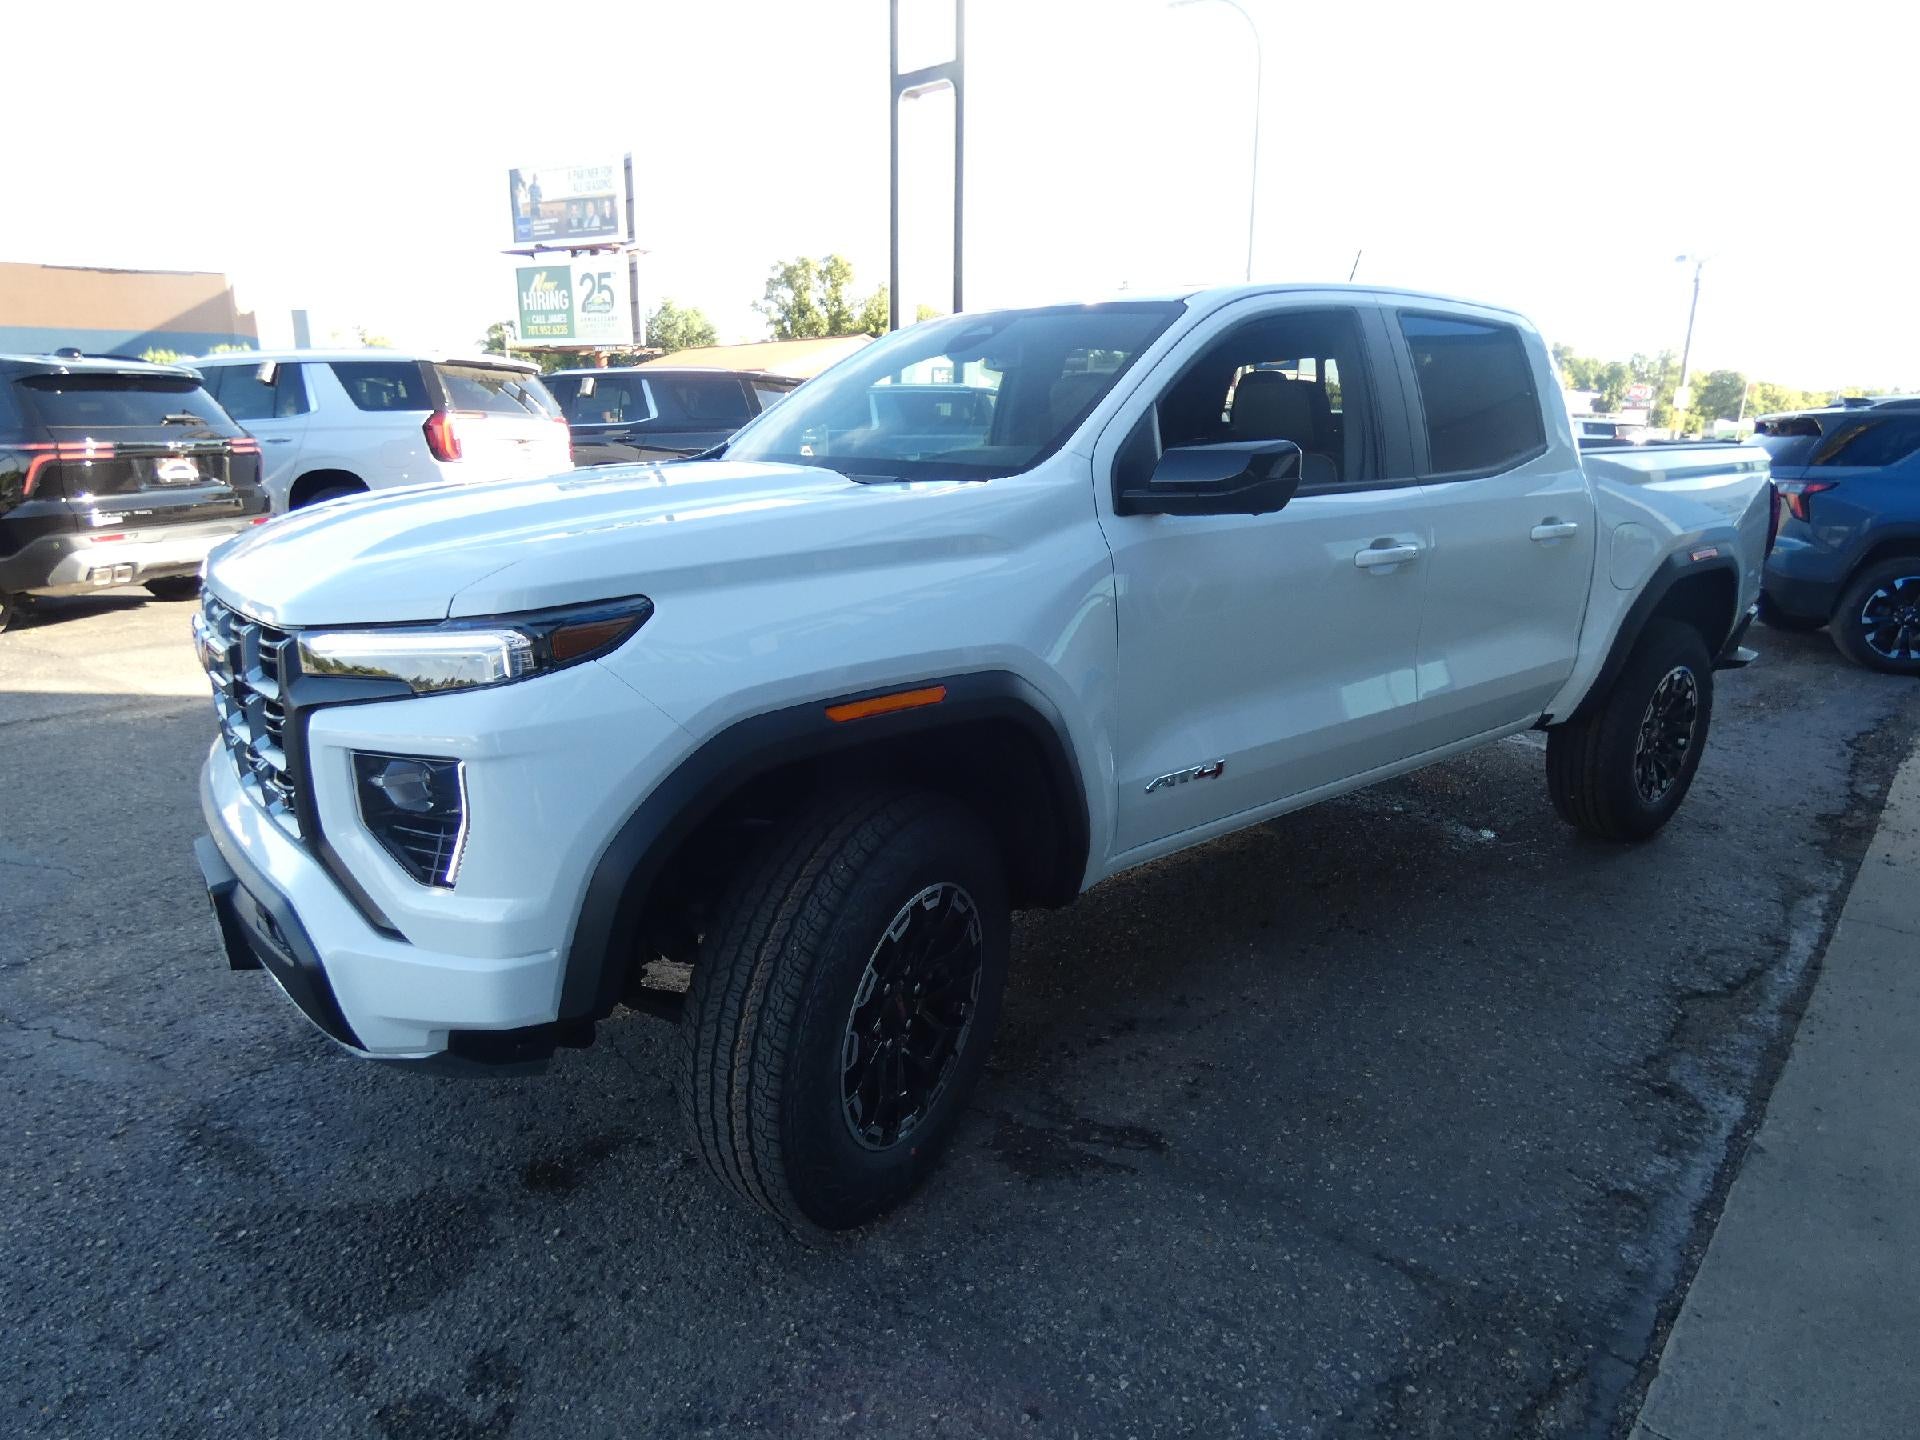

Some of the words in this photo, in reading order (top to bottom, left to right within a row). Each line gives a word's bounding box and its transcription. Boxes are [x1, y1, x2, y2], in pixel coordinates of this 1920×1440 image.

[573, 167, 599, 179] PARTNER
[601, 165, 613, 177] FOR
[522, 290, 569, 311] HIRING
[579, 272, 615, 312] 25
[531, 314, 545, 324] CALL
[1144, 758, 1225, 794] AT4
